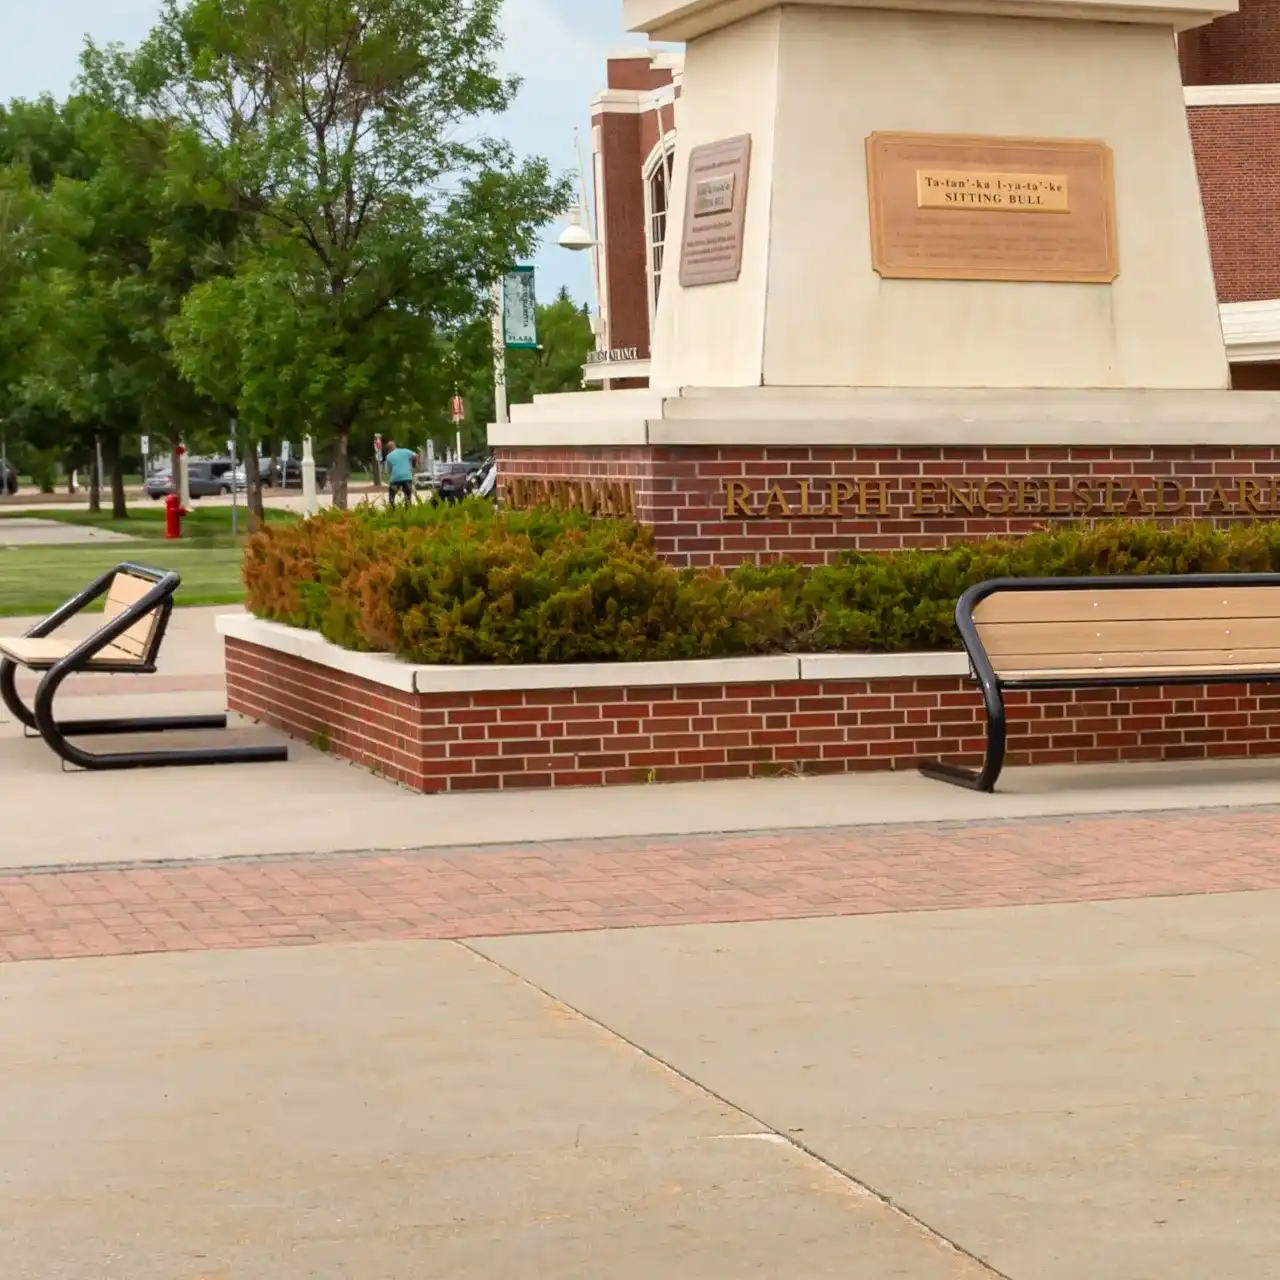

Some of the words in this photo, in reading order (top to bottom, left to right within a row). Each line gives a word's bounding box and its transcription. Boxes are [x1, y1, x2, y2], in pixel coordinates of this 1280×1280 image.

[945, 192, 1002, 203] SITTING
[1009, 195, 1045, 205] BULL
[722, 479, 891, 517] RALPH
[910, 477, 1188, 517] ENGELSTAD
